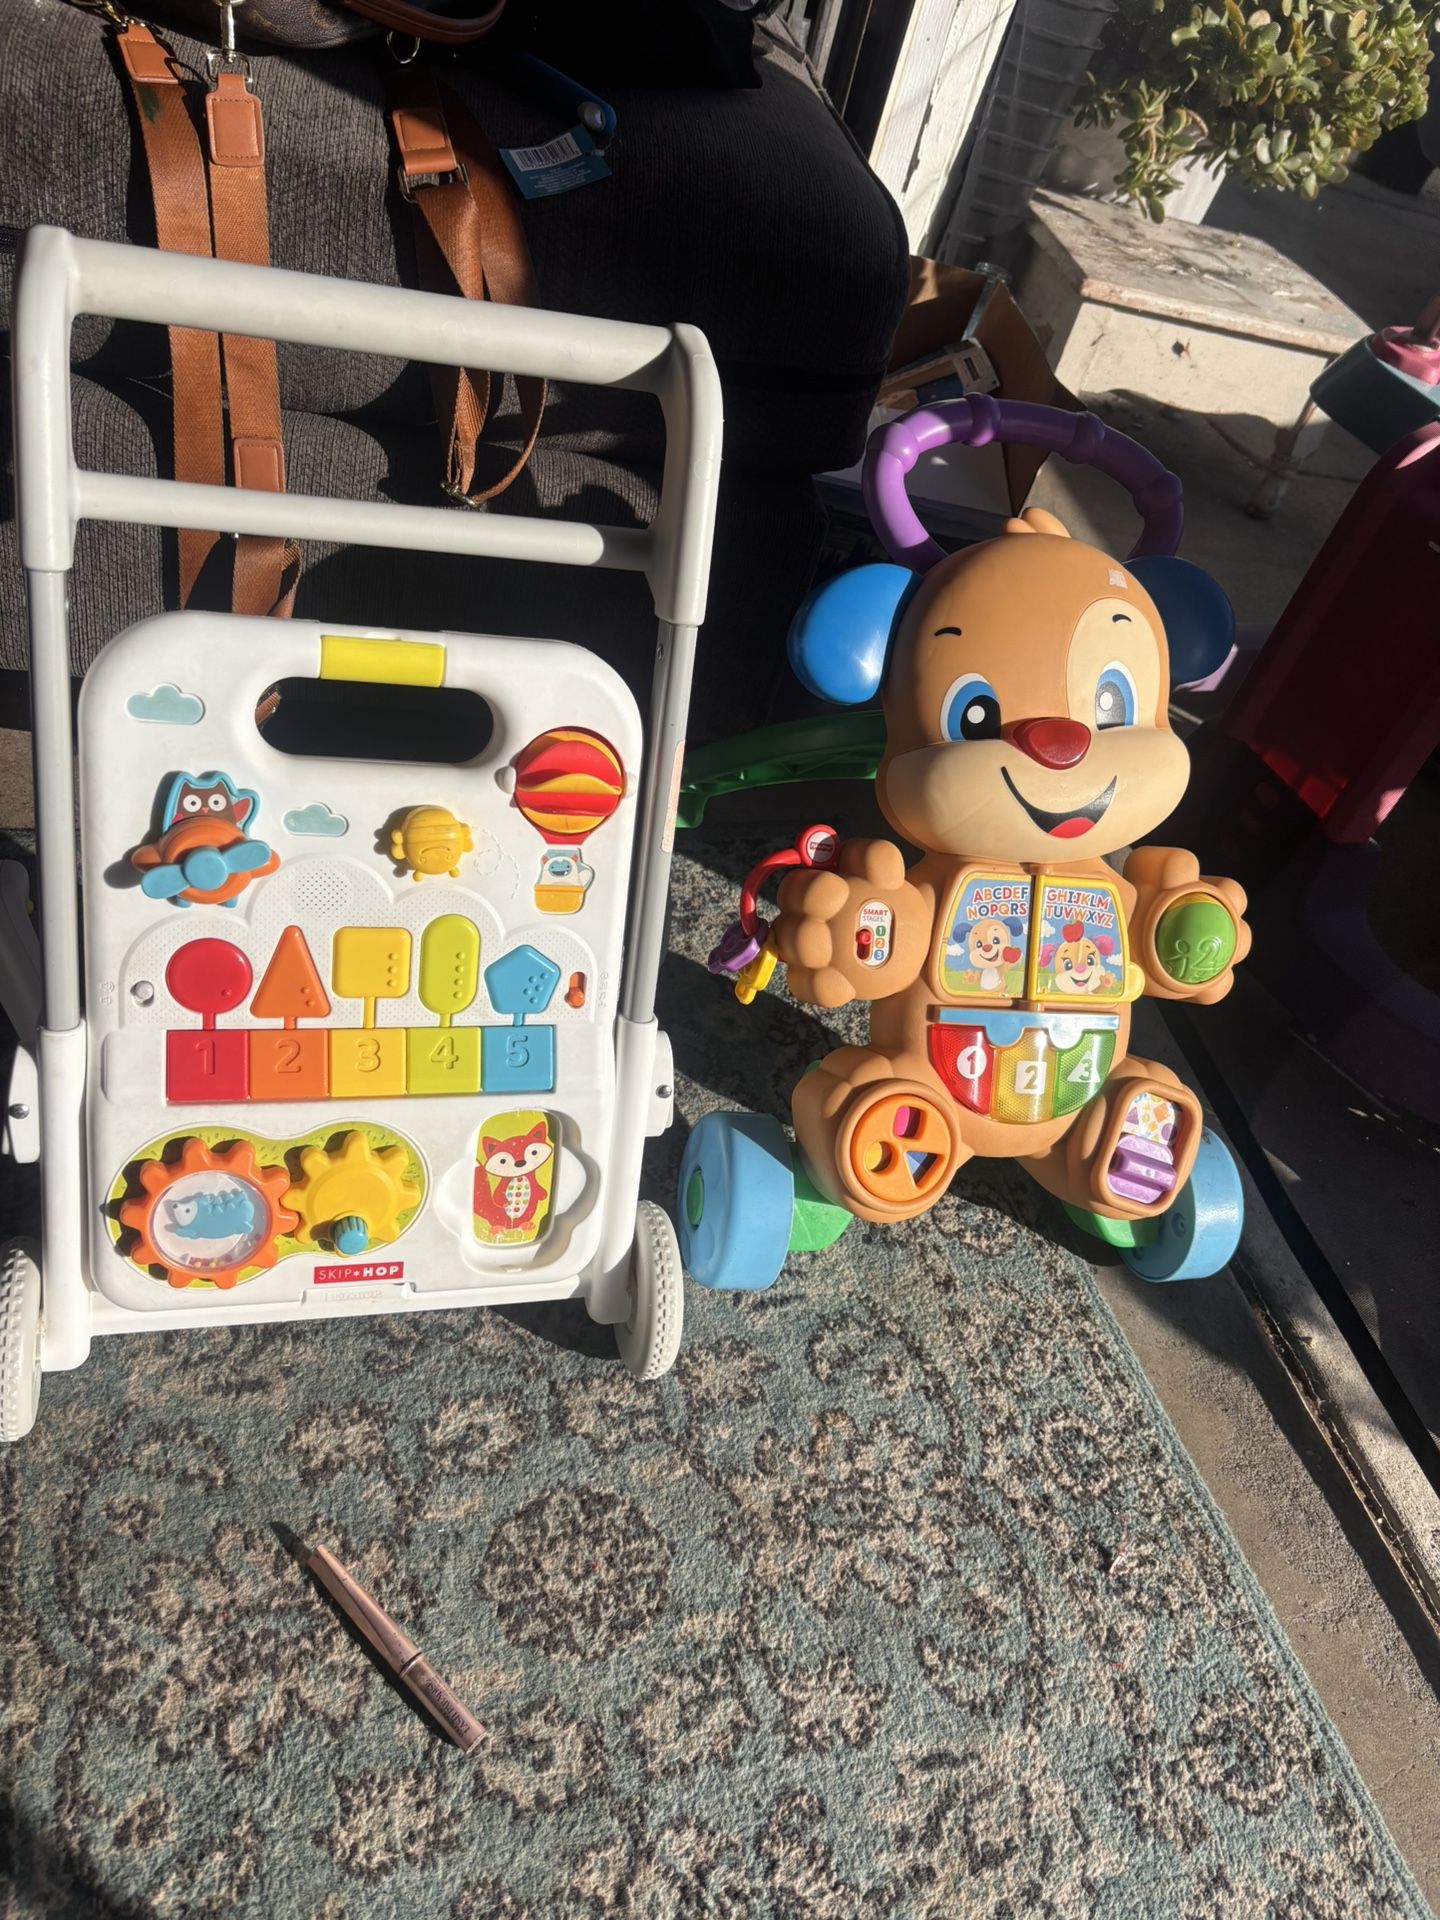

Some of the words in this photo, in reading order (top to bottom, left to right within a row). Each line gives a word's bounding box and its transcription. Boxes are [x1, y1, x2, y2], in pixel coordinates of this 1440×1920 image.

[973, 887, 1029, 903] ABCDEF
[1046, 889, 1111, 910] GHIJKLM
[863, 908, 889, 916] SMART
[966, 902, 1028, 920] NOPQRS
[1045, 904, 1113, 927] TUVWXYZ
[195, 1039, 216, 1076] 1
[274, 1038, 302, 1074] 2
[353, 1037, 381, 1073] 3
[428, 1035, 459, 1070] 4
[505, 1033, 530, 1068] 5
[966, 1050, 977, 1075] 1
[1023, 1065, 1039, 1090] 2
[1078, 1058, 1093, 1081] 3
[362, 1265, 399, 1277] HOP
